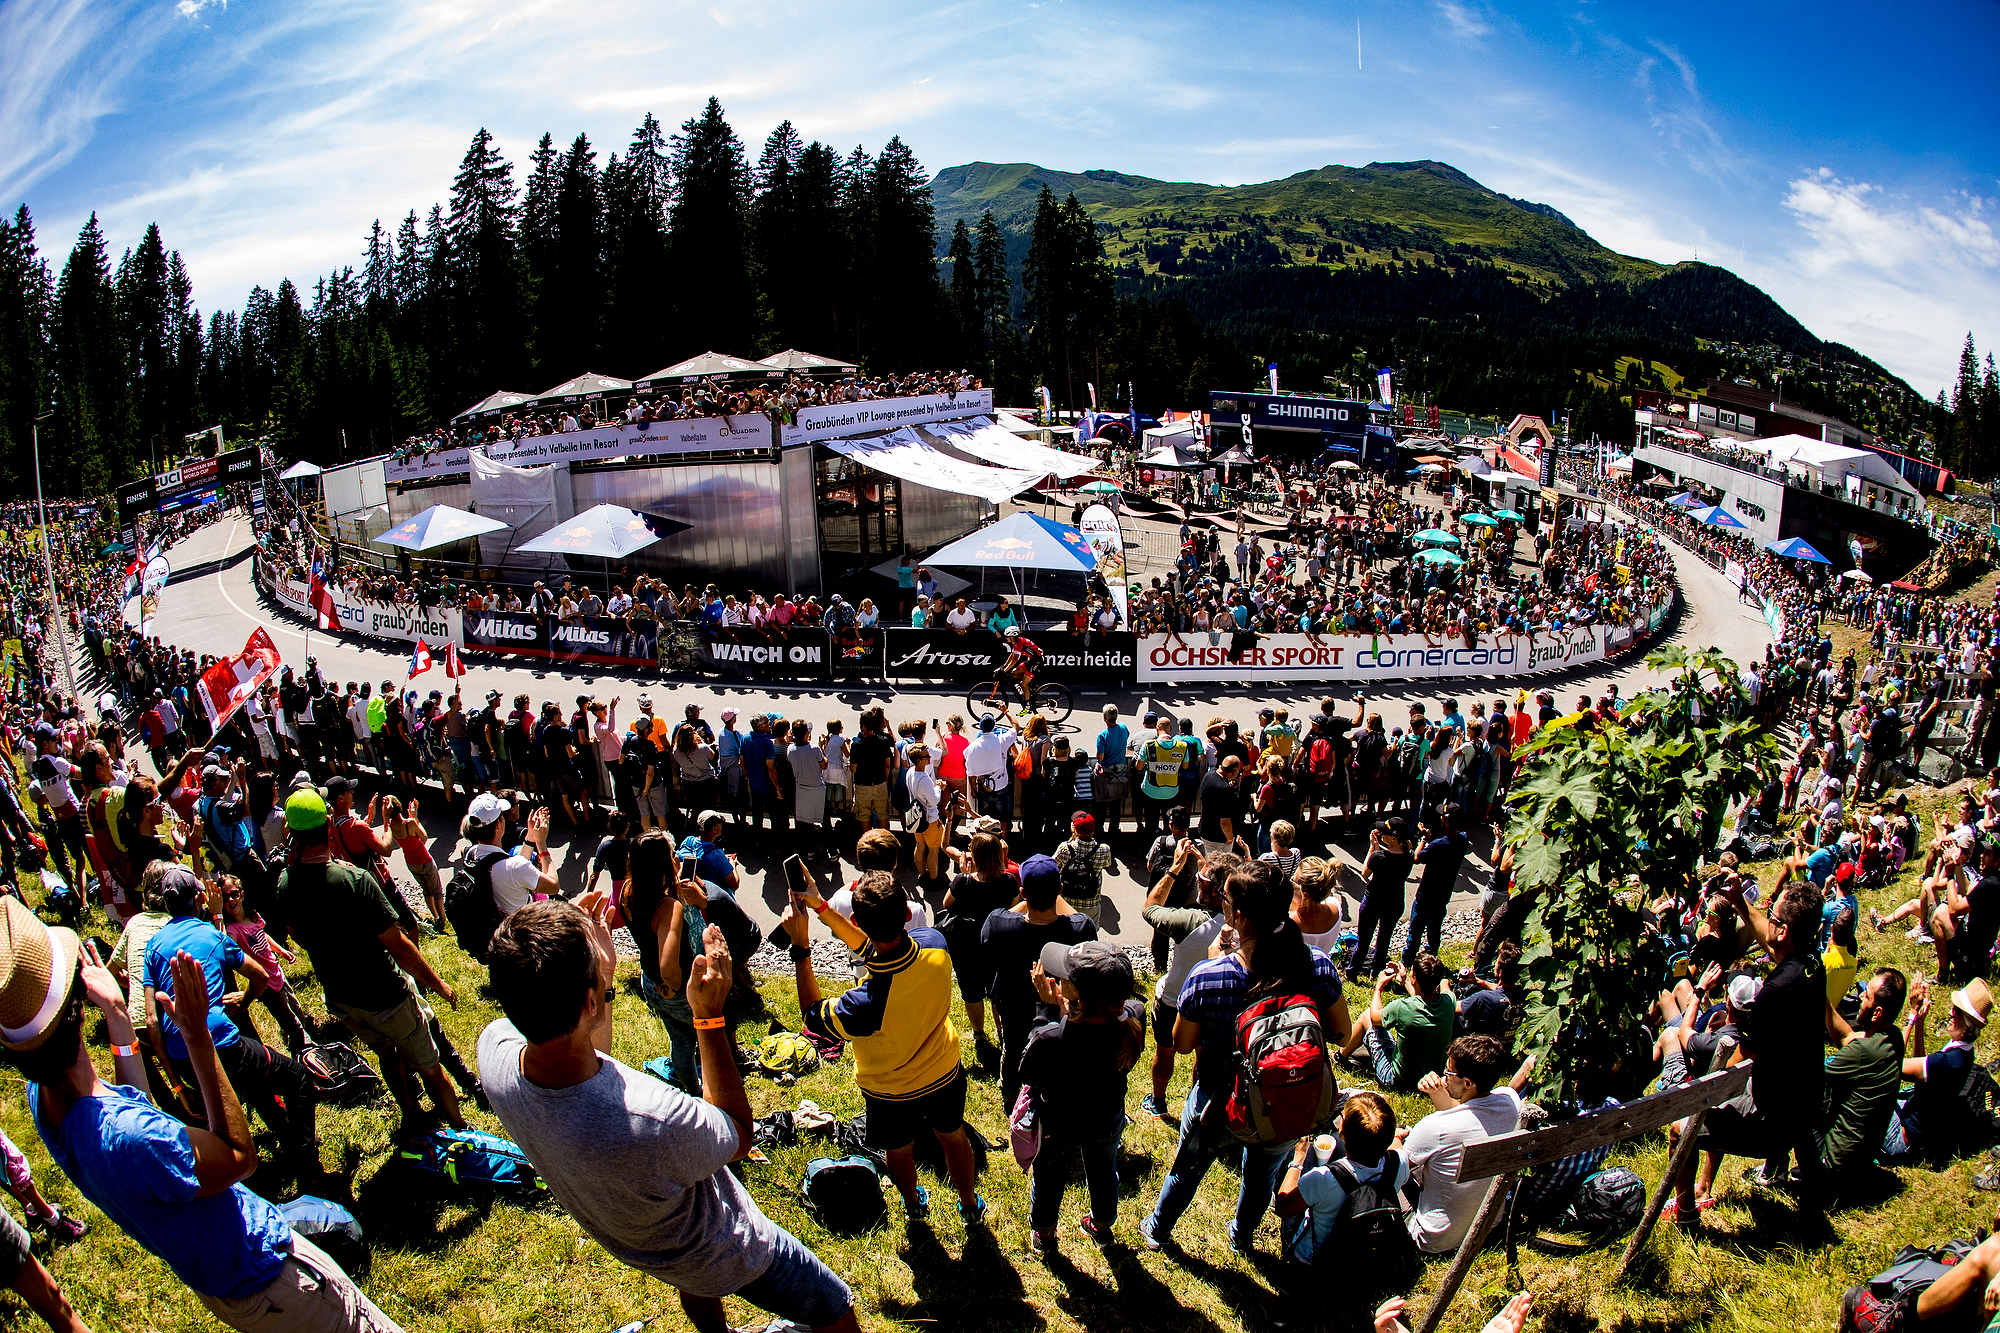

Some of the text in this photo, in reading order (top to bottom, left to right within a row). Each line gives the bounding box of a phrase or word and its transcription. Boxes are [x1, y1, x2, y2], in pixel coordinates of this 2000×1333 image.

[805, 400, 981, 431] Graubünden VIP Lounge presented by Valbella Inn Resort
[1268, 403, 1349, 421] SHIMANO
[508, 448, 538, 460] presented
[539, 445, 548, 455] by
[549, 442, 578, 454] Valbella
[580, 442, 592, 451] Inn
[594, 438, 619, 450] Resort
[183, 464, 206, 474] MOUNTAIN
[228, 460, 252, 472] FINISH
[1540, 452, 1550, 485] CHOPFAB
[159, 471, 181, 487] UCI
[184, 471, 200, 480] WORLD
[126, 490, 148, 504] FINISH
[551, 538, 592, 548] Red Bull
[974, 550, 1035, 561] Red Bull
[472, 618, 536, 640] Mitas
[552, 626, 610, 644] Mitas
[711, 643, 821, 663] WATCH ON
[891, 644, 992, 667] Arosa
[1272, 648, 1344, 666] SPORT
